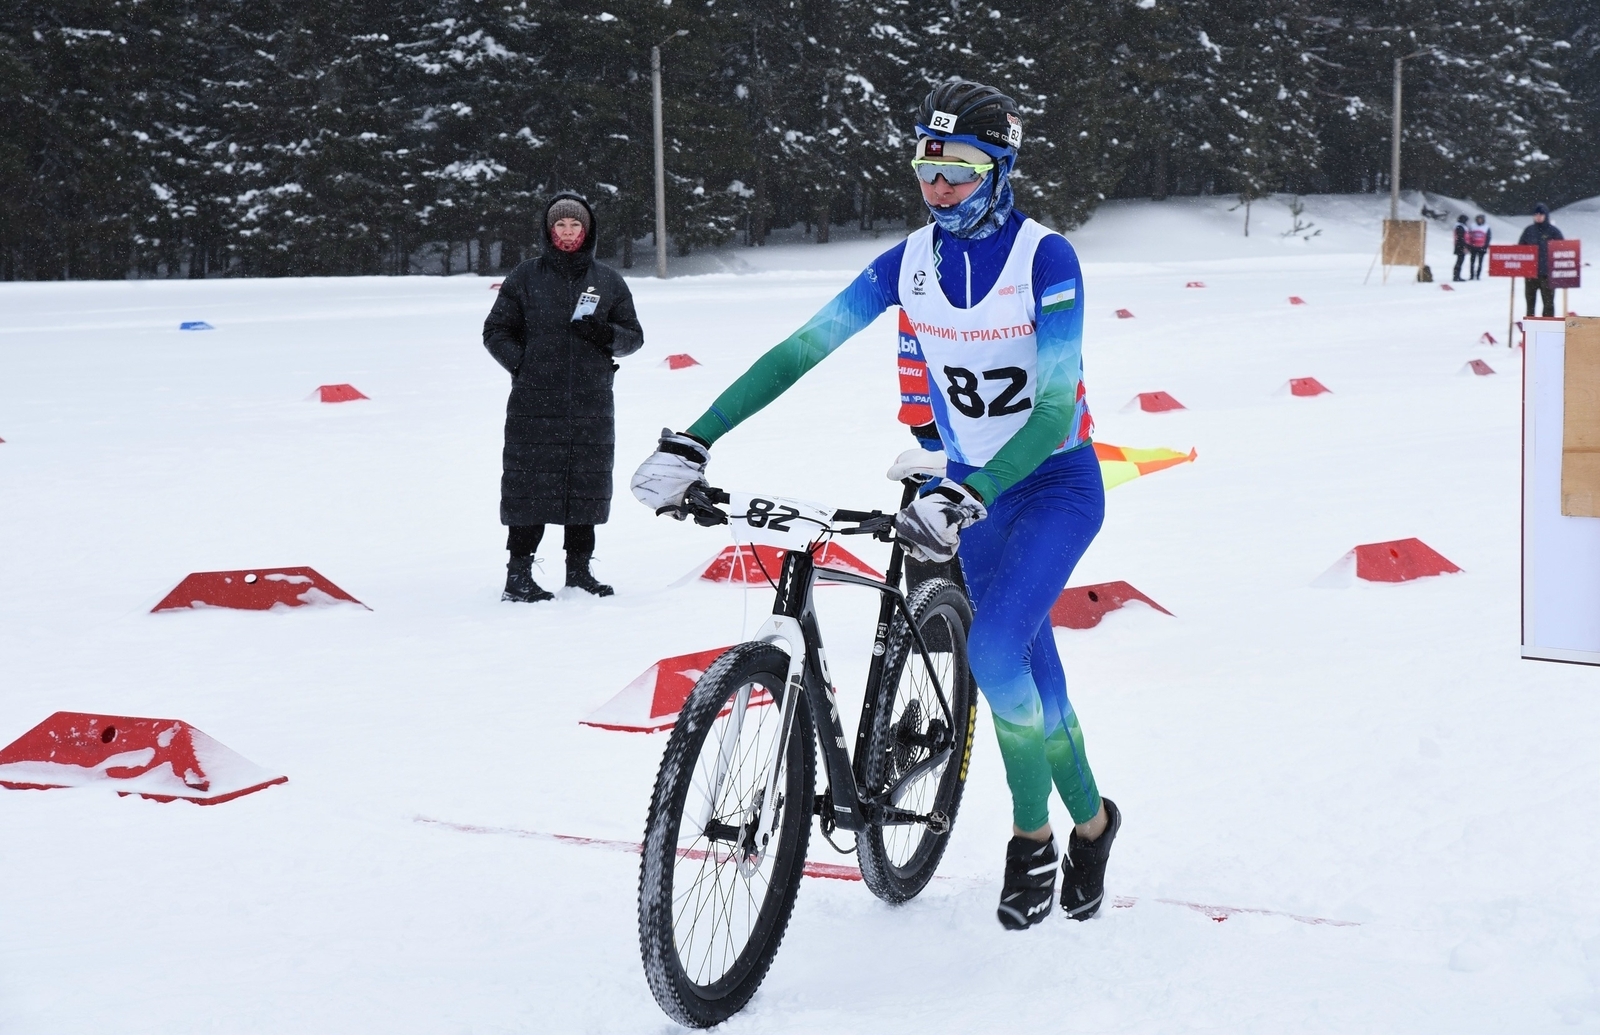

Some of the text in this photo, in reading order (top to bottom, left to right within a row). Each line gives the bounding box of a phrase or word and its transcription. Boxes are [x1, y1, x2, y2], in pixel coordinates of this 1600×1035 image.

[933, 115, 950, 129] 82
[1010, 129, 1020, 142] 82
[960, 321, 1036, 342] ТРИАТЛО
[898, 335, 918, 355] ЬЯ
[943, 365, 1033, 419] 82
[746, 498, 800, 533] 82
